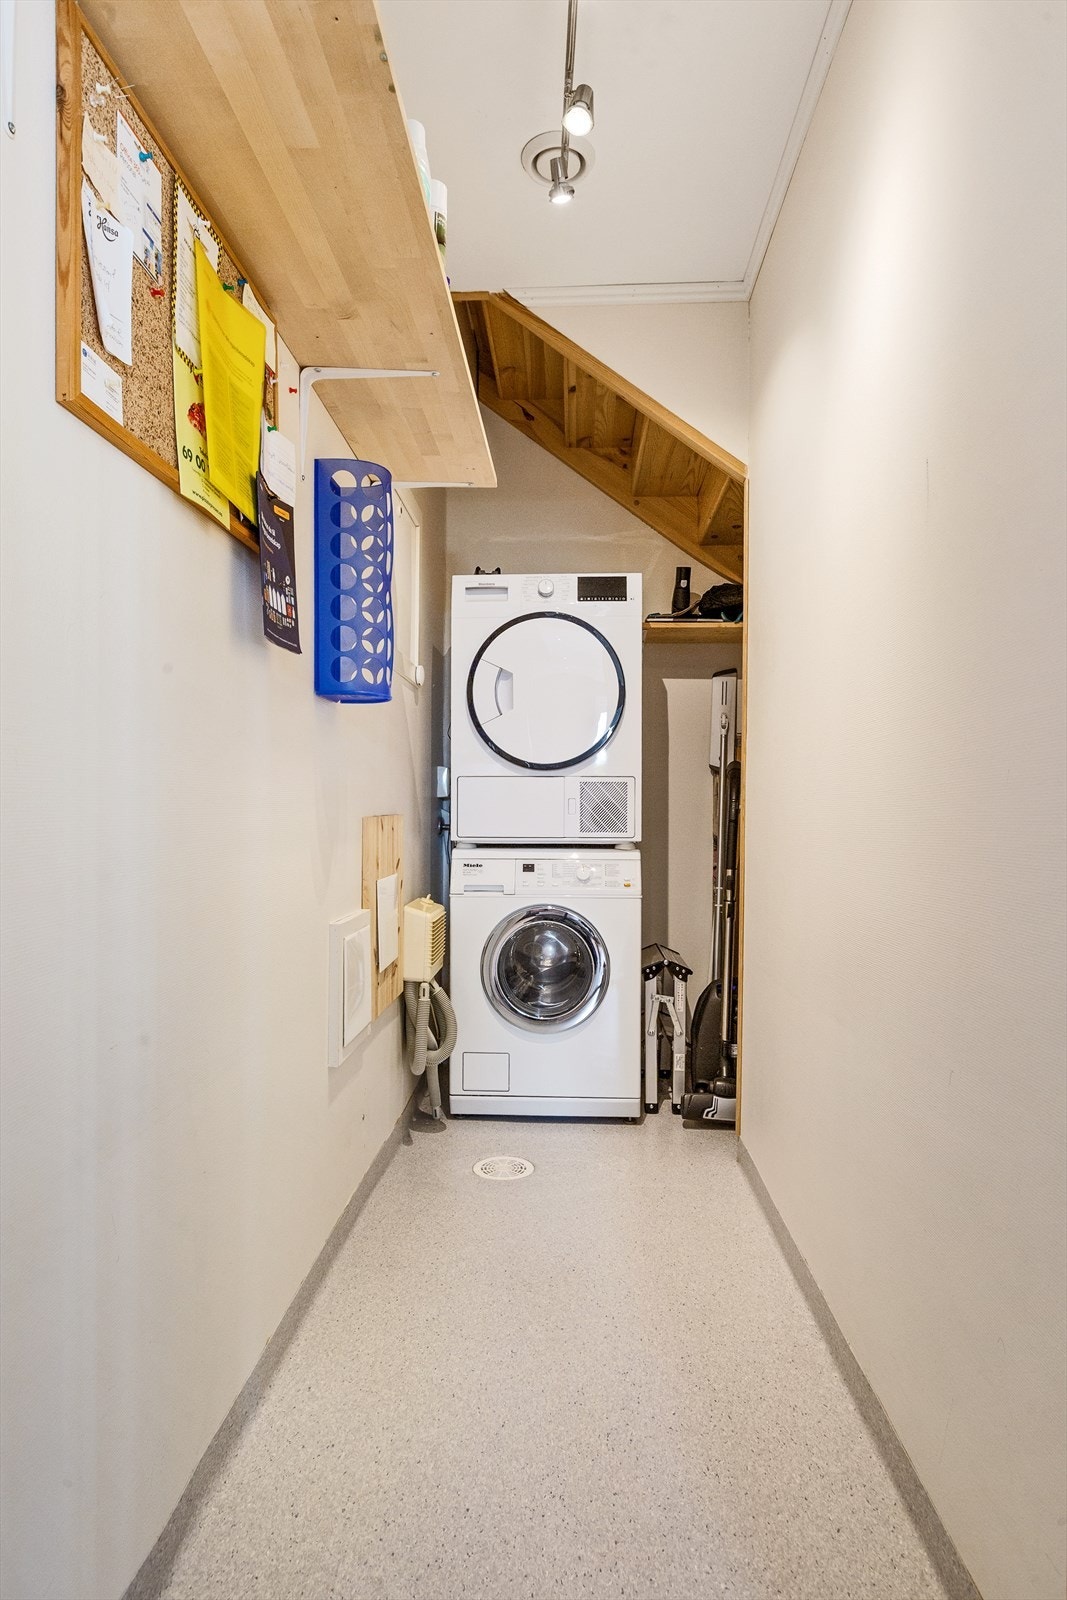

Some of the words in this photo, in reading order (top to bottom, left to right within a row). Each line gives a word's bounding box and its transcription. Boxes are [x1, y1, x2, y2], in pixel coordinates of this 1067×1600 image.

[97, 215, 119, 242] Hansa
[182, 446, 193, 462] 69
[195, 455, 206, 472] 00
